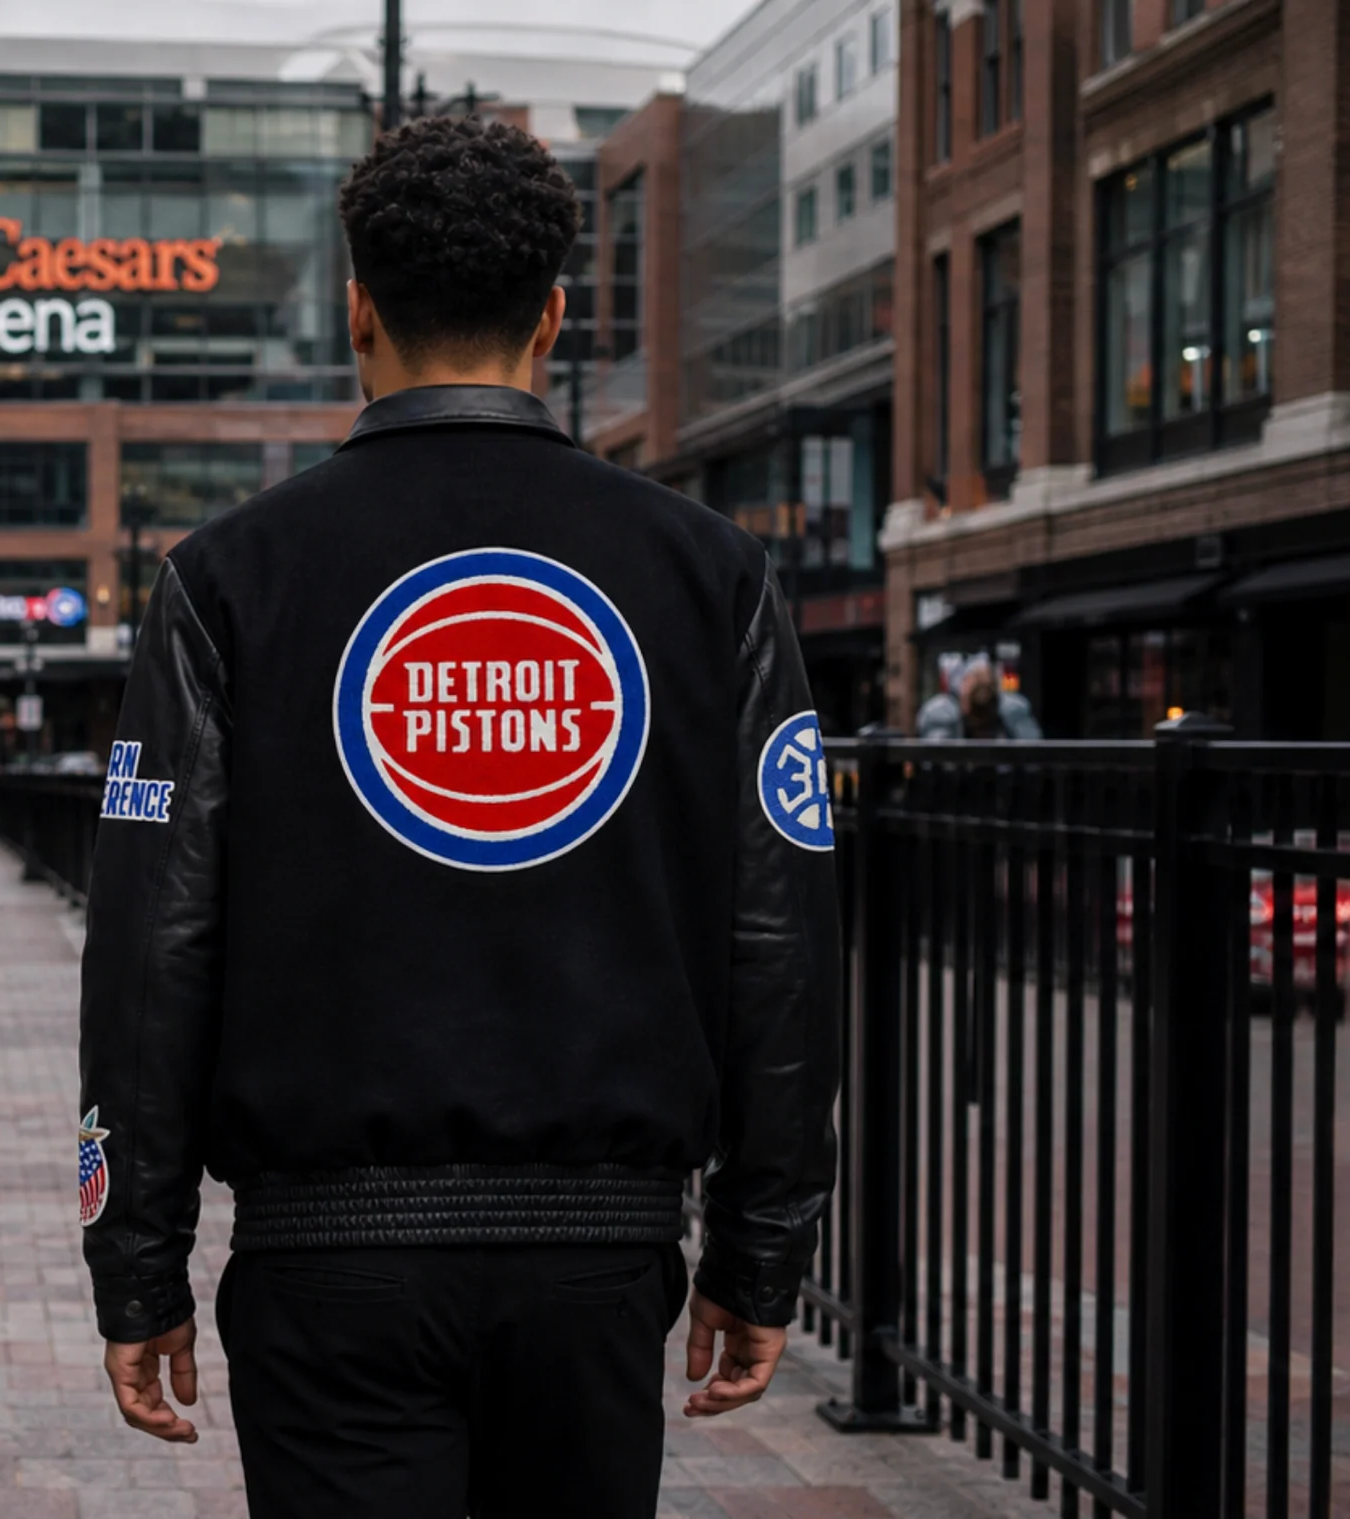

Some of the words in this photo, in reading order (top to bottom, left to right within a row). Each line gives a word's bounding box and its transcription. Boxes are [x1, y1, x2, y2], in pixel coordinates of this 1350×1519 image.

[403, 659, 580, 703] DETROIT
[402, 708, 581, 753] PISTONS
[108, 741, 142, 780] RN
[100, 779, 174, 822] RENCE
